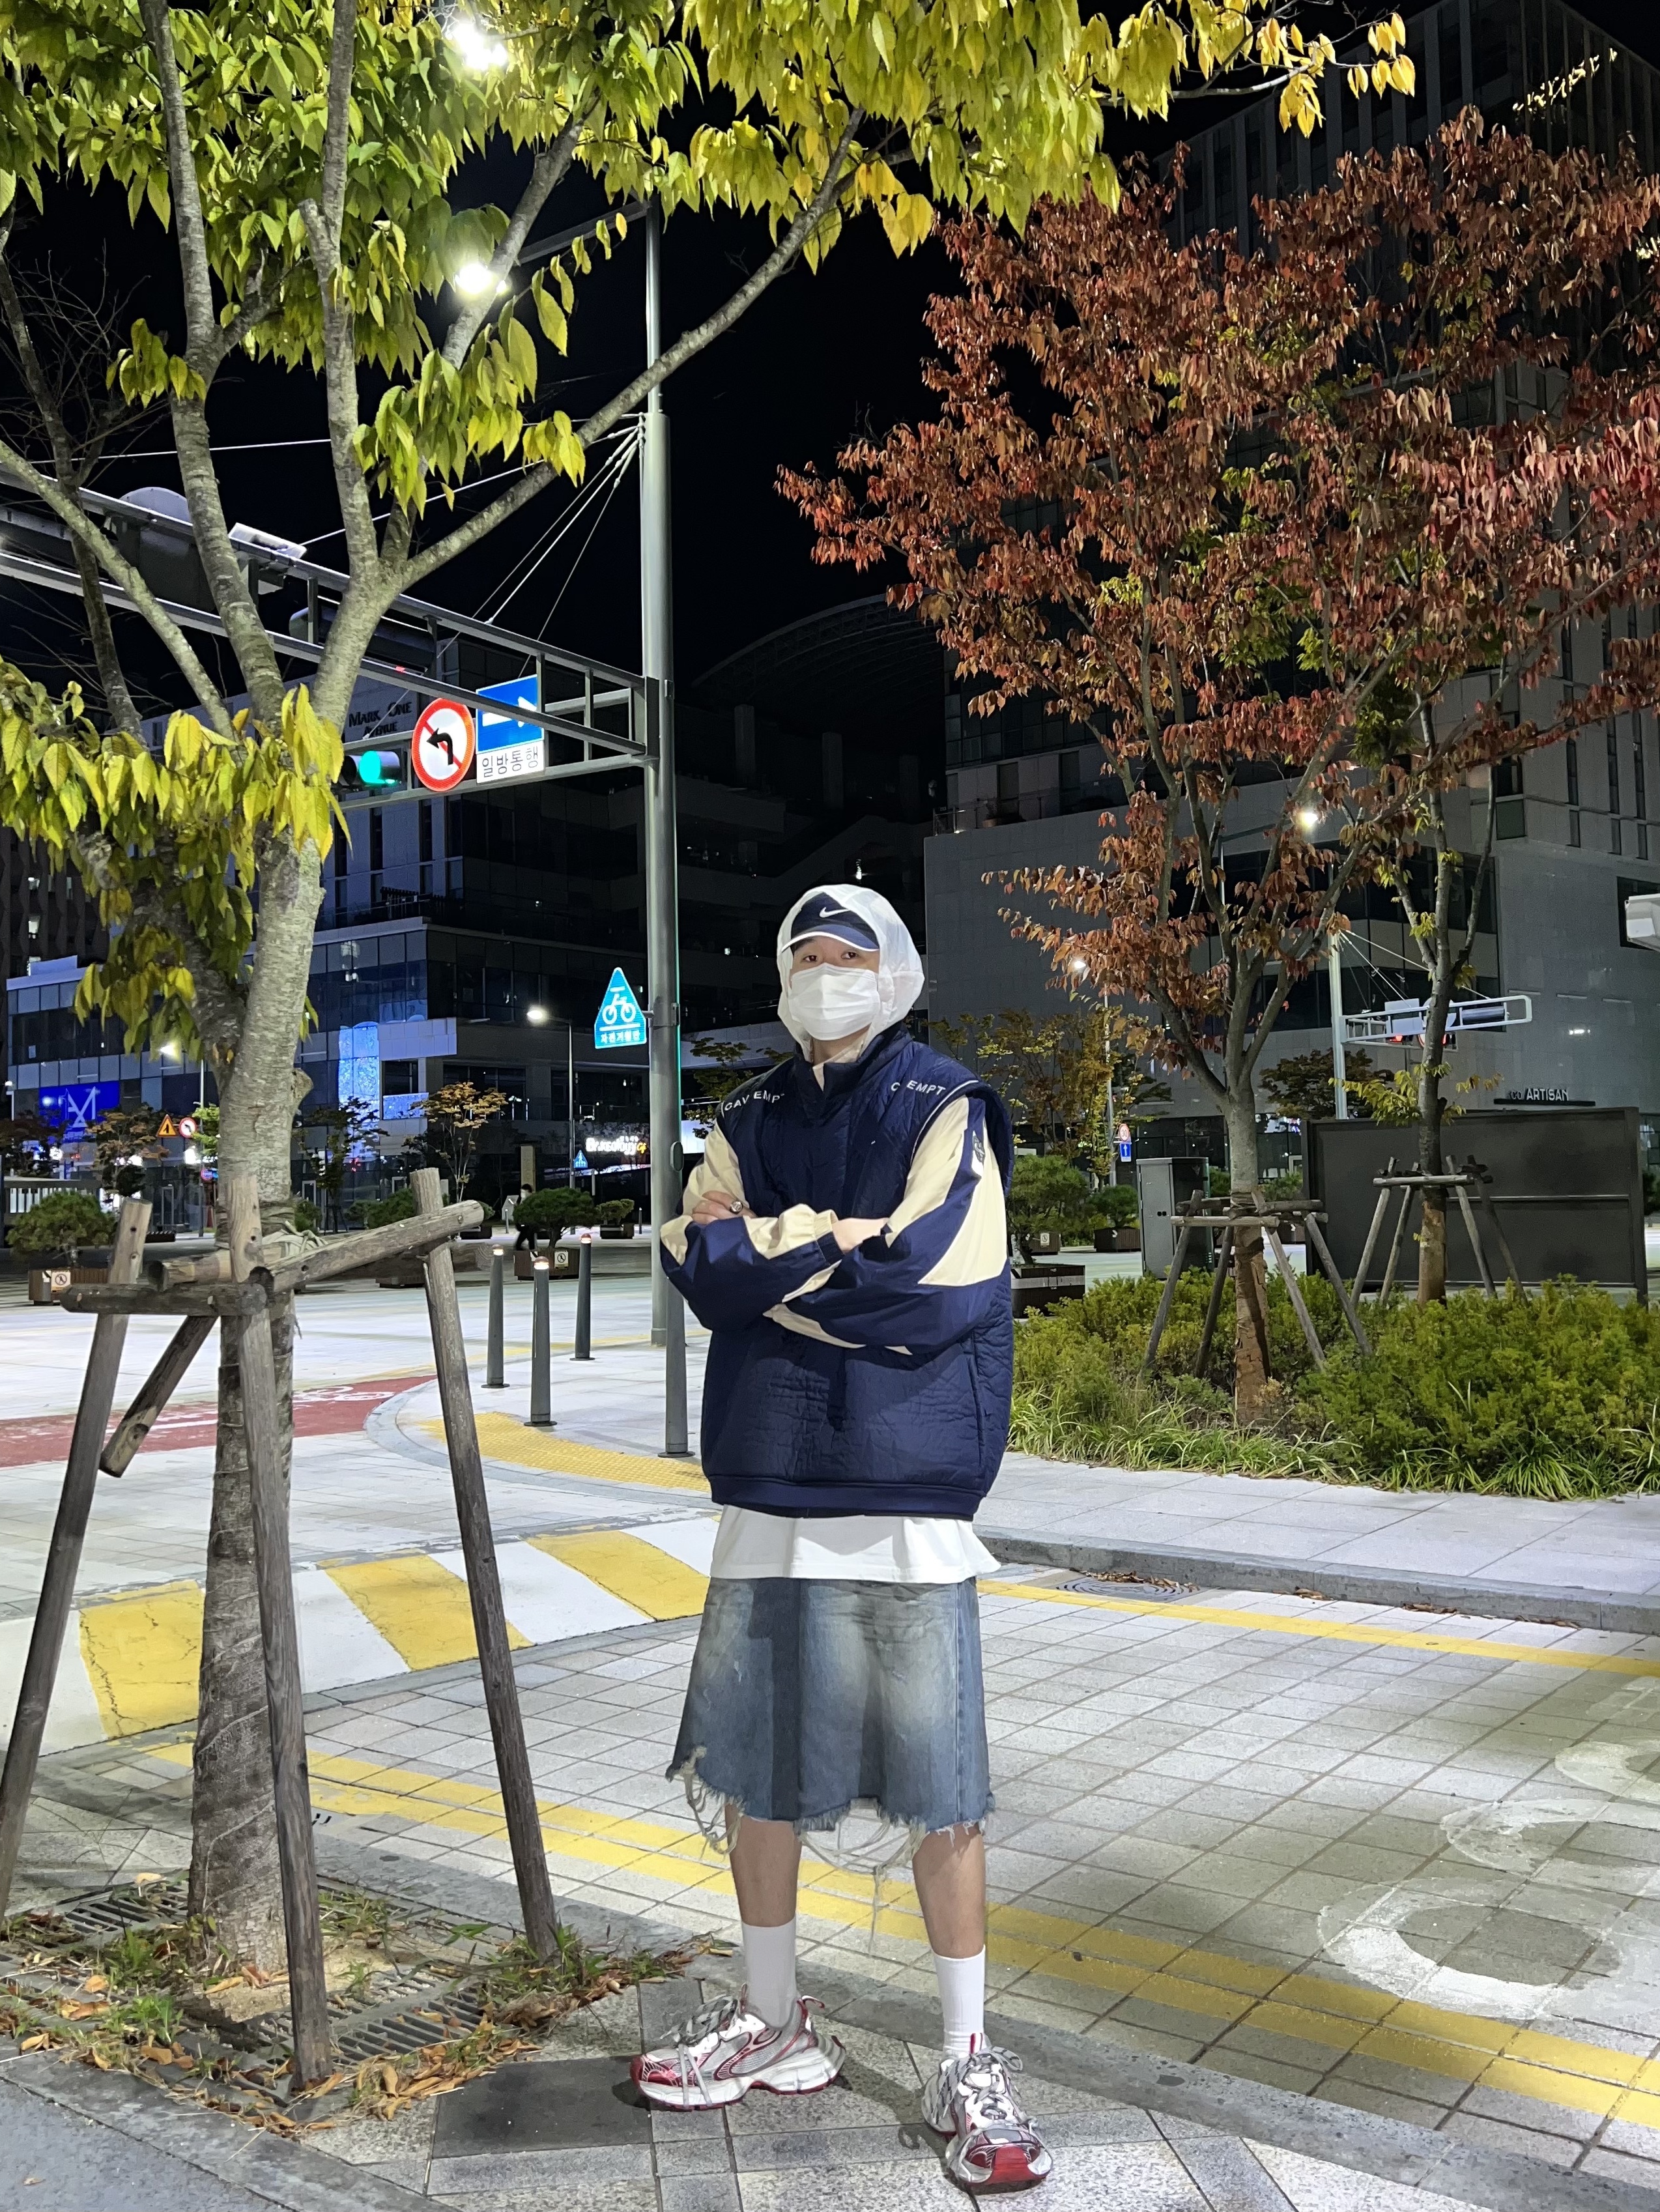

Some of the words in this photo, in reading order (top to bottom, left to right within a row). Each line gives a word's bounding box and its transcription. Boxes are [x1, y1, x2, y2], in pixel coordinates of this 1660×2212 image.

[349, 710, 381, 727] MARK
[388, 702, 412, 717] ONE
[481, 745, 539, 778] 일방통행
[907, 1080, 946, 1095] EMPT
[1525, 1087, 1569, 1101] ARTISAN
